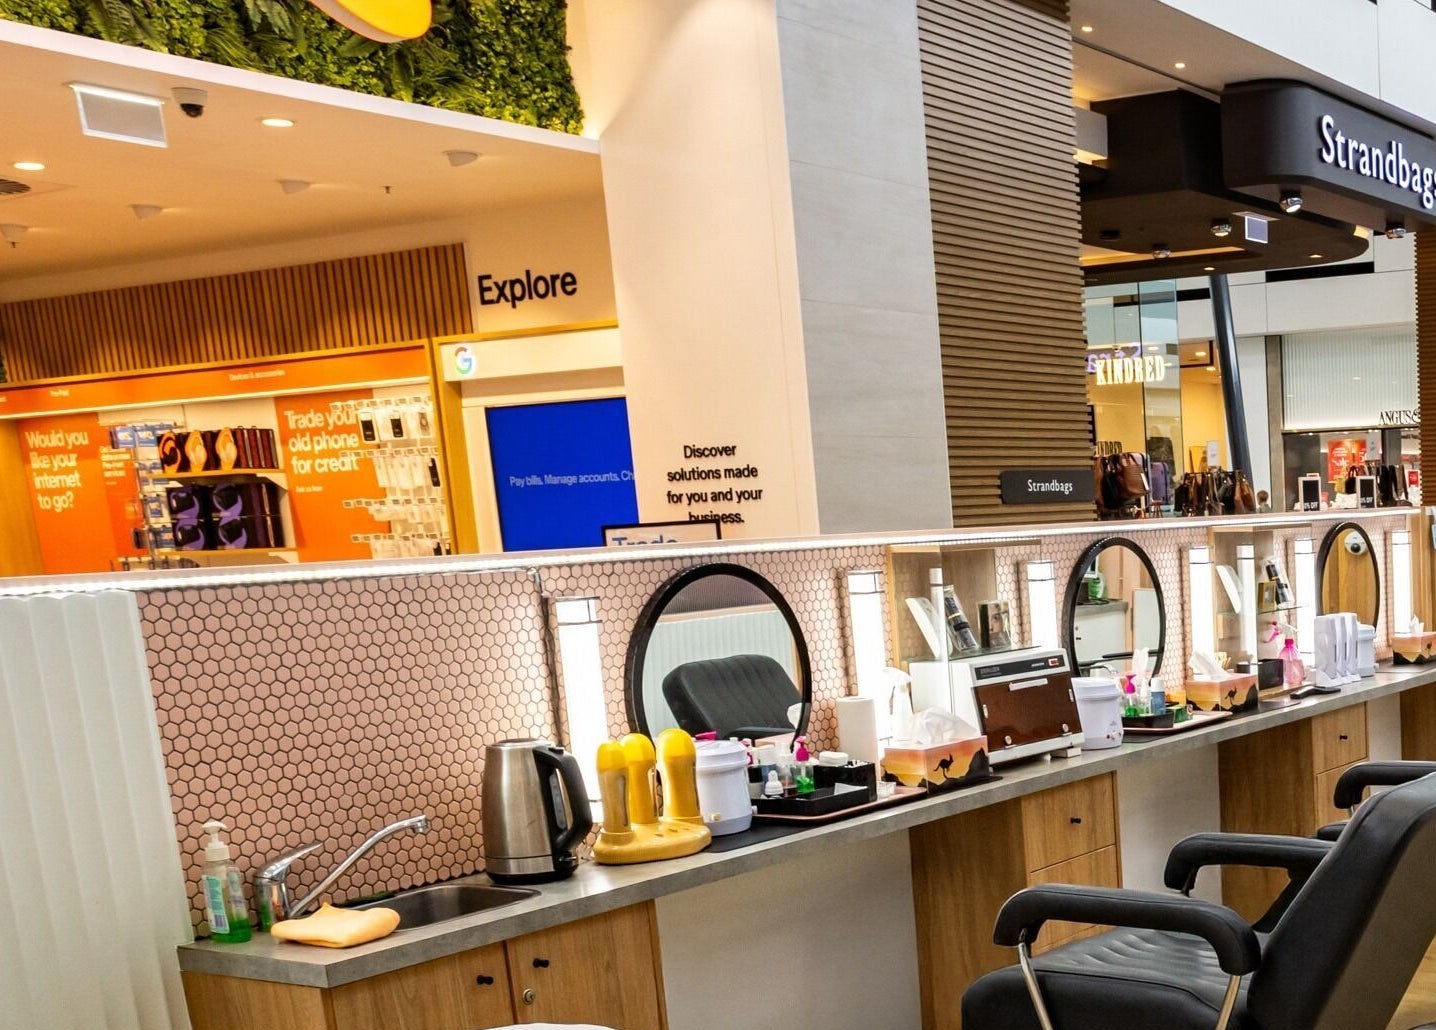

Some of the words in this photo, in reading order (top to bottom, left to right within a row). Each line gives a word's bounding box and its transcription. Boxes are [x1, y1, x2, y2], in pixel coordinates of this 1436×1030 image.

[477, 269, 578, 309] Explore
[454, 346, 473, 375] G
[1095, 355, 1165, 385] KINDRED
[284, 409, 325, 430] Trade
[326, 407, 358, 430] your
[25, 430, 64, 448] Would
[65, 432, 90, 449] you
[288, 436, 312, 452] old
[313, 432, 360, 454] phone
[683, 444, 738, 459] Discover
[29, 452, 51, 469] like
[51, 453, 78, 471] your
[290, 456, 314, 474] for
[314, 455, 361, 473] credit
[33, 471, 82, 489] internet
[509, 475, 526, 488] Pay
[525, 474, 544, 487] bills.
[544, 473, 578, 486] Manage
[578, 471, 620, 483] accounts.
[667, 467, 722, 482] solutions
[723, 464, 759, 479] made
[666, 490, 684, 504] for
[685, 492, 709, 506] you
[710, 487, 734, 502] and
[735, 489, 764, 504] your
[1027, 479, 1073, 495] Strandbags
[37, 494, 52, 510] to
[53, 491, 75, 512] go?
